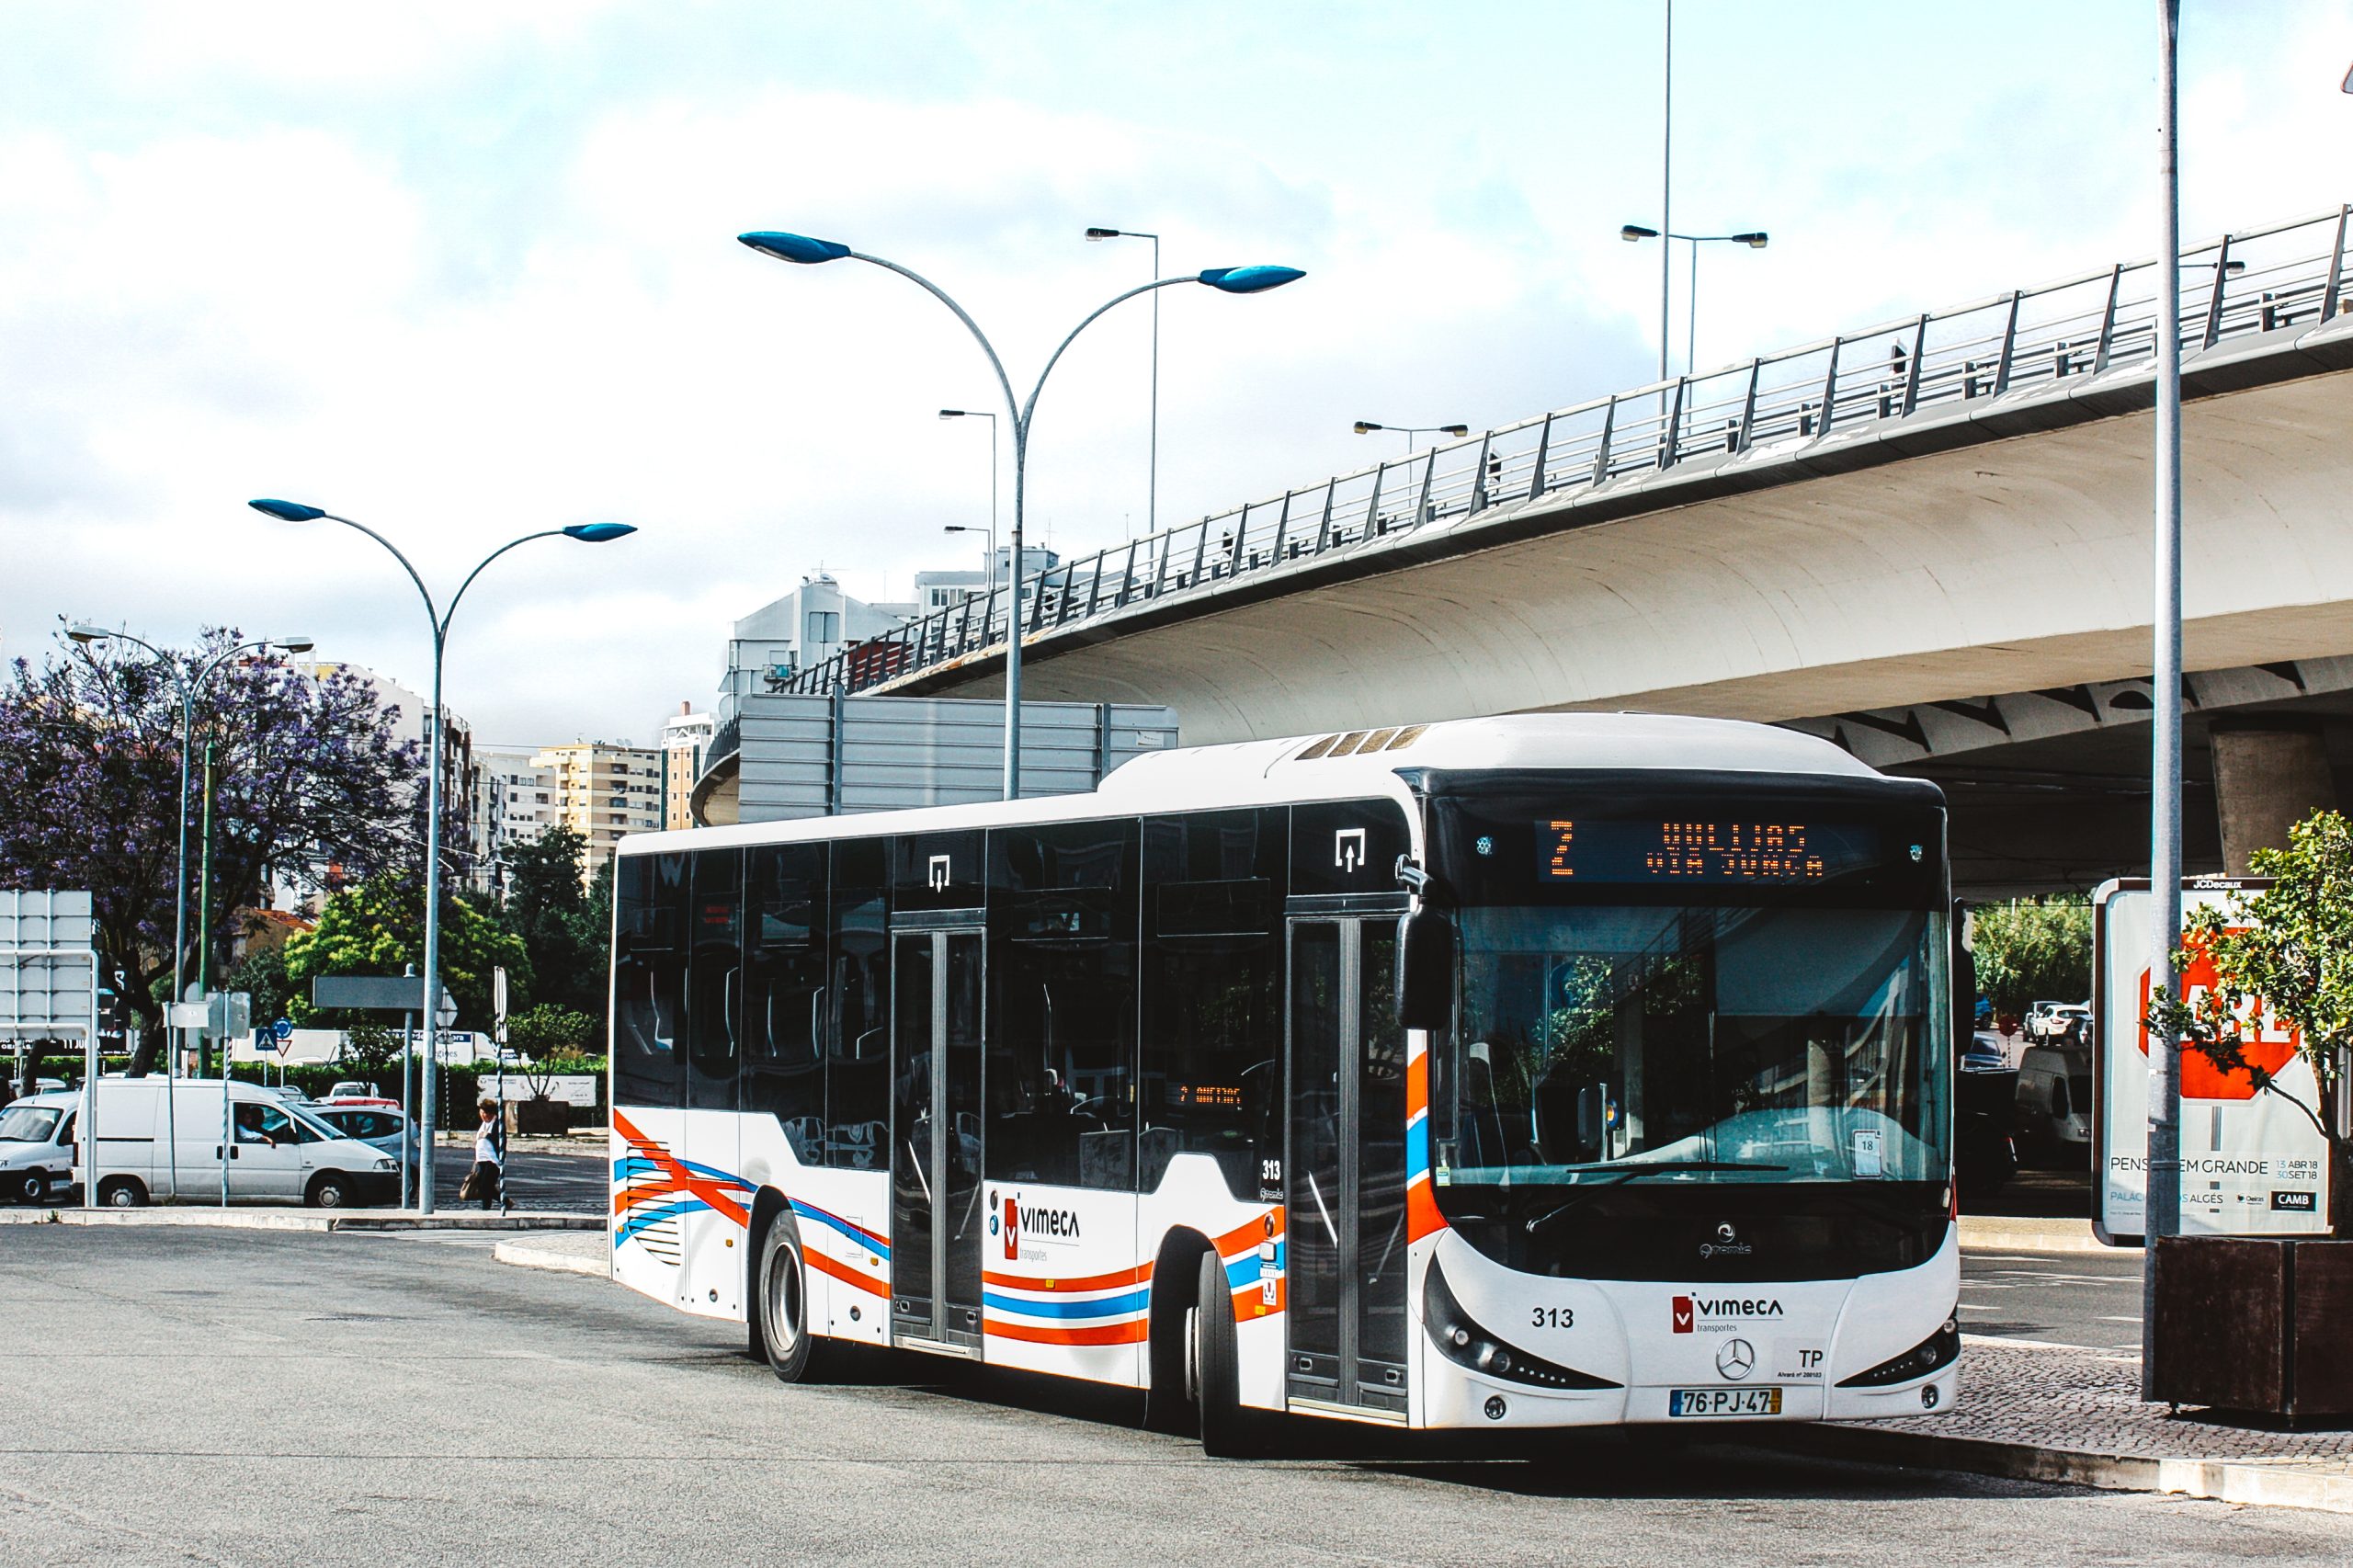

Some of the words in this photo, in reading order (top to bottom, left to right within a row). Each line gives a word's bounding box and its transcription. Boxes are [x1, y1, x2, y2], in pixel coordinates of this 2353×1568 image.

[2192, 880, 2242, 889] JCDecaux
[1861, 1140, 1873, 1151] 18
[1262, 1159, 1281, 1181] 313
[2201, 1159, 2269, 1175] GRANDE
[2288, 1160, 2308, 1169] ABR
[2309, 1161, 2318, 1169] 18
[2288, 1171, 2306, 1179] SET
[2308, 1171, 2317, 1180] 18
[2189, 1192, 2223, 1204] ALGÉS
[2278, 1194, 2310, 1205] CAMB
[1019, 1247, 1048, 1263] transportes
[1531, 1307, 1574, 1329] 313
[1697, 1324, 1737, 1333] transportes
[1798, 1349, 1824, 1368] TP
